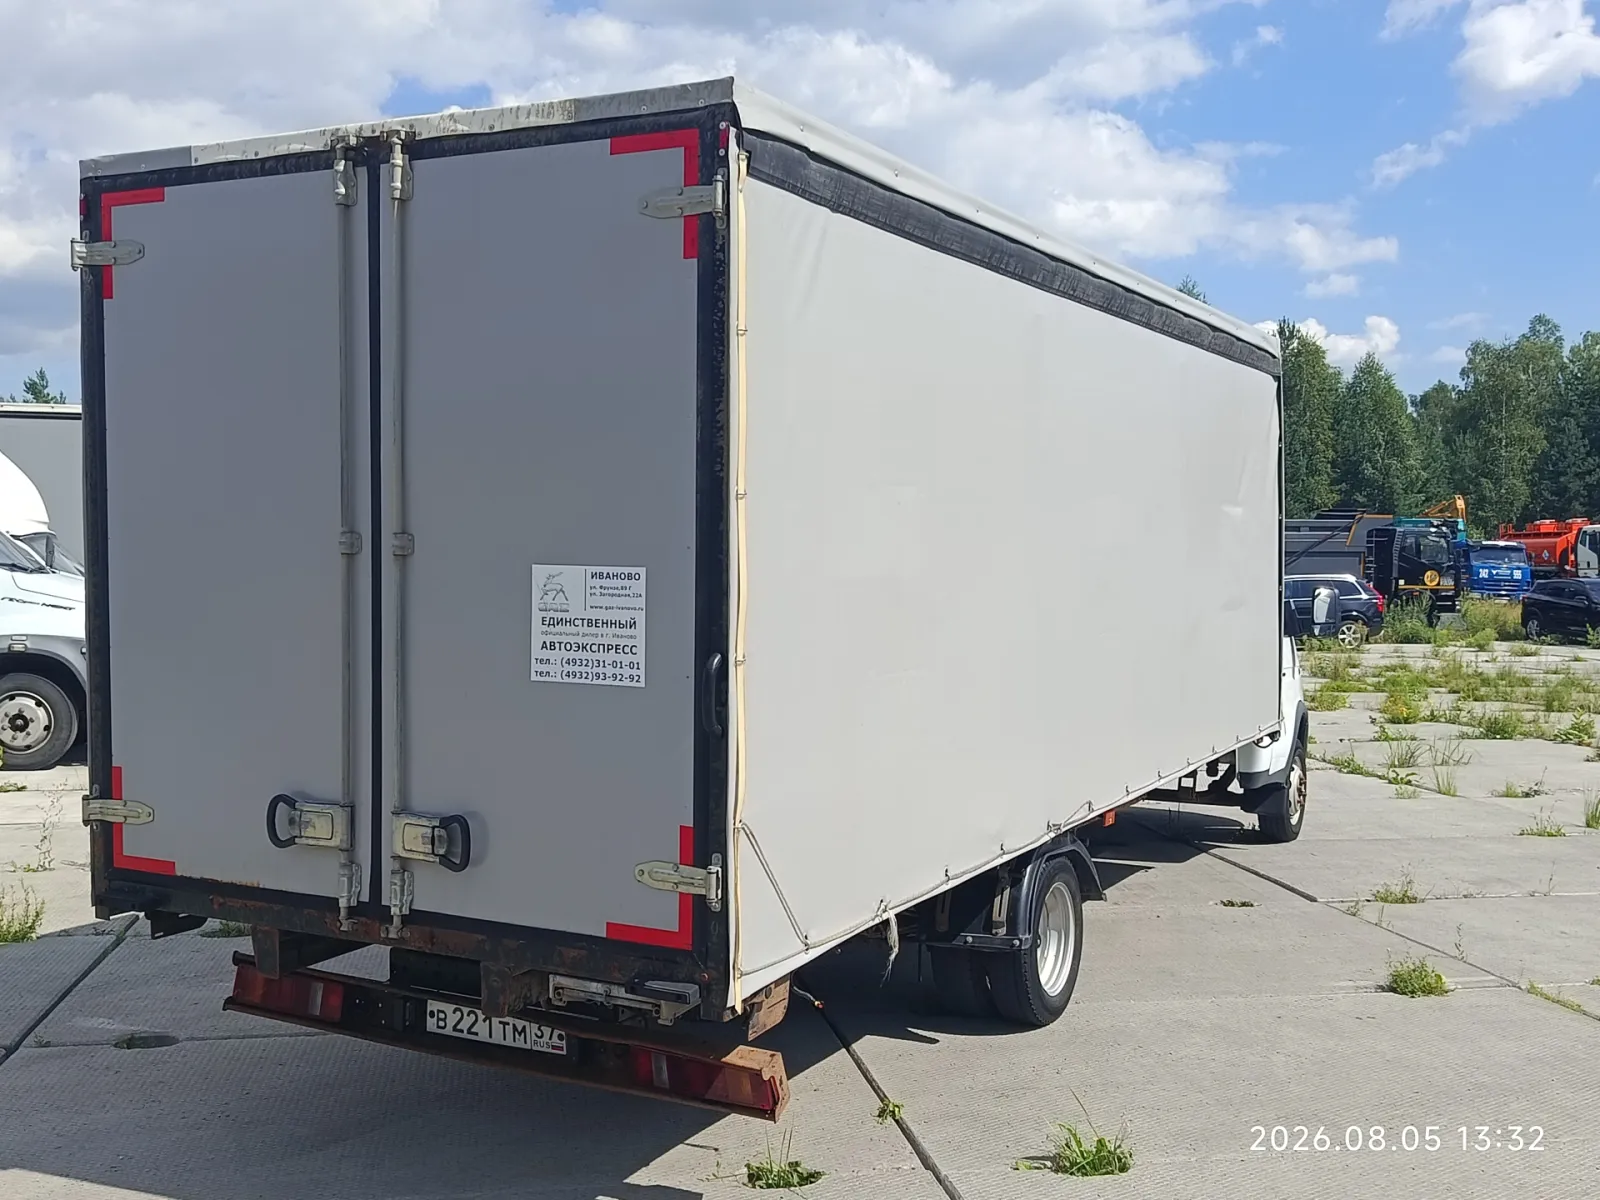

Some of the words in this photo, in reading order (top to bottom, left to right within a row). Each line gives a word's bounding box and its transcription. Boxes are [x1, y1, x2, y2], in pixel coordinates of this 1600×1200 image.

[590, 571, 641, 581] ИВАНОВО
[541, 616, 637, 630] ЕДИНСТВЕННЫЙ
[612, 632, 637, 640] Иваново
[540, 640, 638, 655] АВТОЭКСПРЕСС
[534, 657, 557, 666] тел.:
[560, 657, 641, 671] (4932)31-01-01
[534, 670, 557, 678] тел.:
[560, 669, 641, 683] (4932)93-92-92
[533, 1039, 551, 1049] RUS
